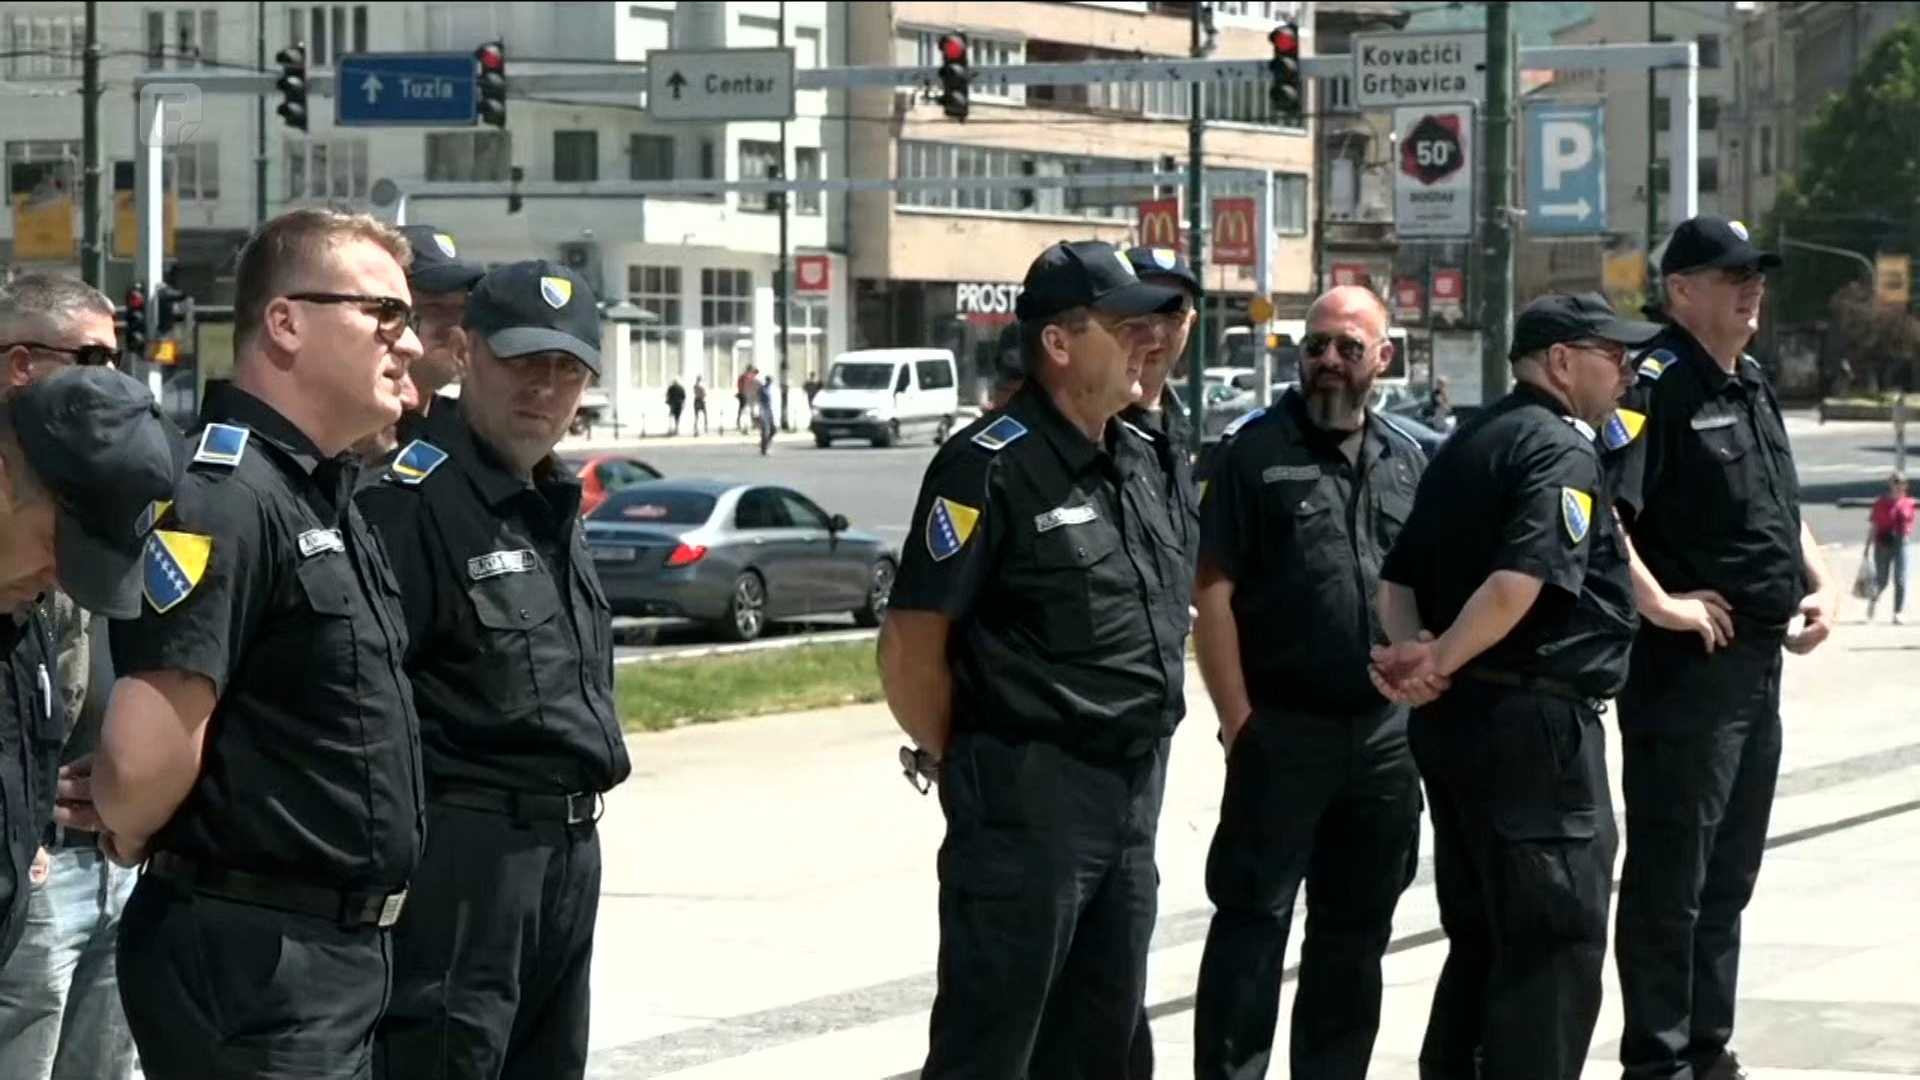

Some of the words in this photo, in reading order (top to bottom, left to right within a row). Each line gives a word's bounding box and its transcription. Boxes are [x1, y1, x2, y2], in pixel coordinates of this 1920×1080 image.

[1362, 43, 1462, 66] Kovačići
[400, 77, 454, 98] Tuzla
[705, 73, 775, 94] Centar
[1541, 121, 1593, 191] P
